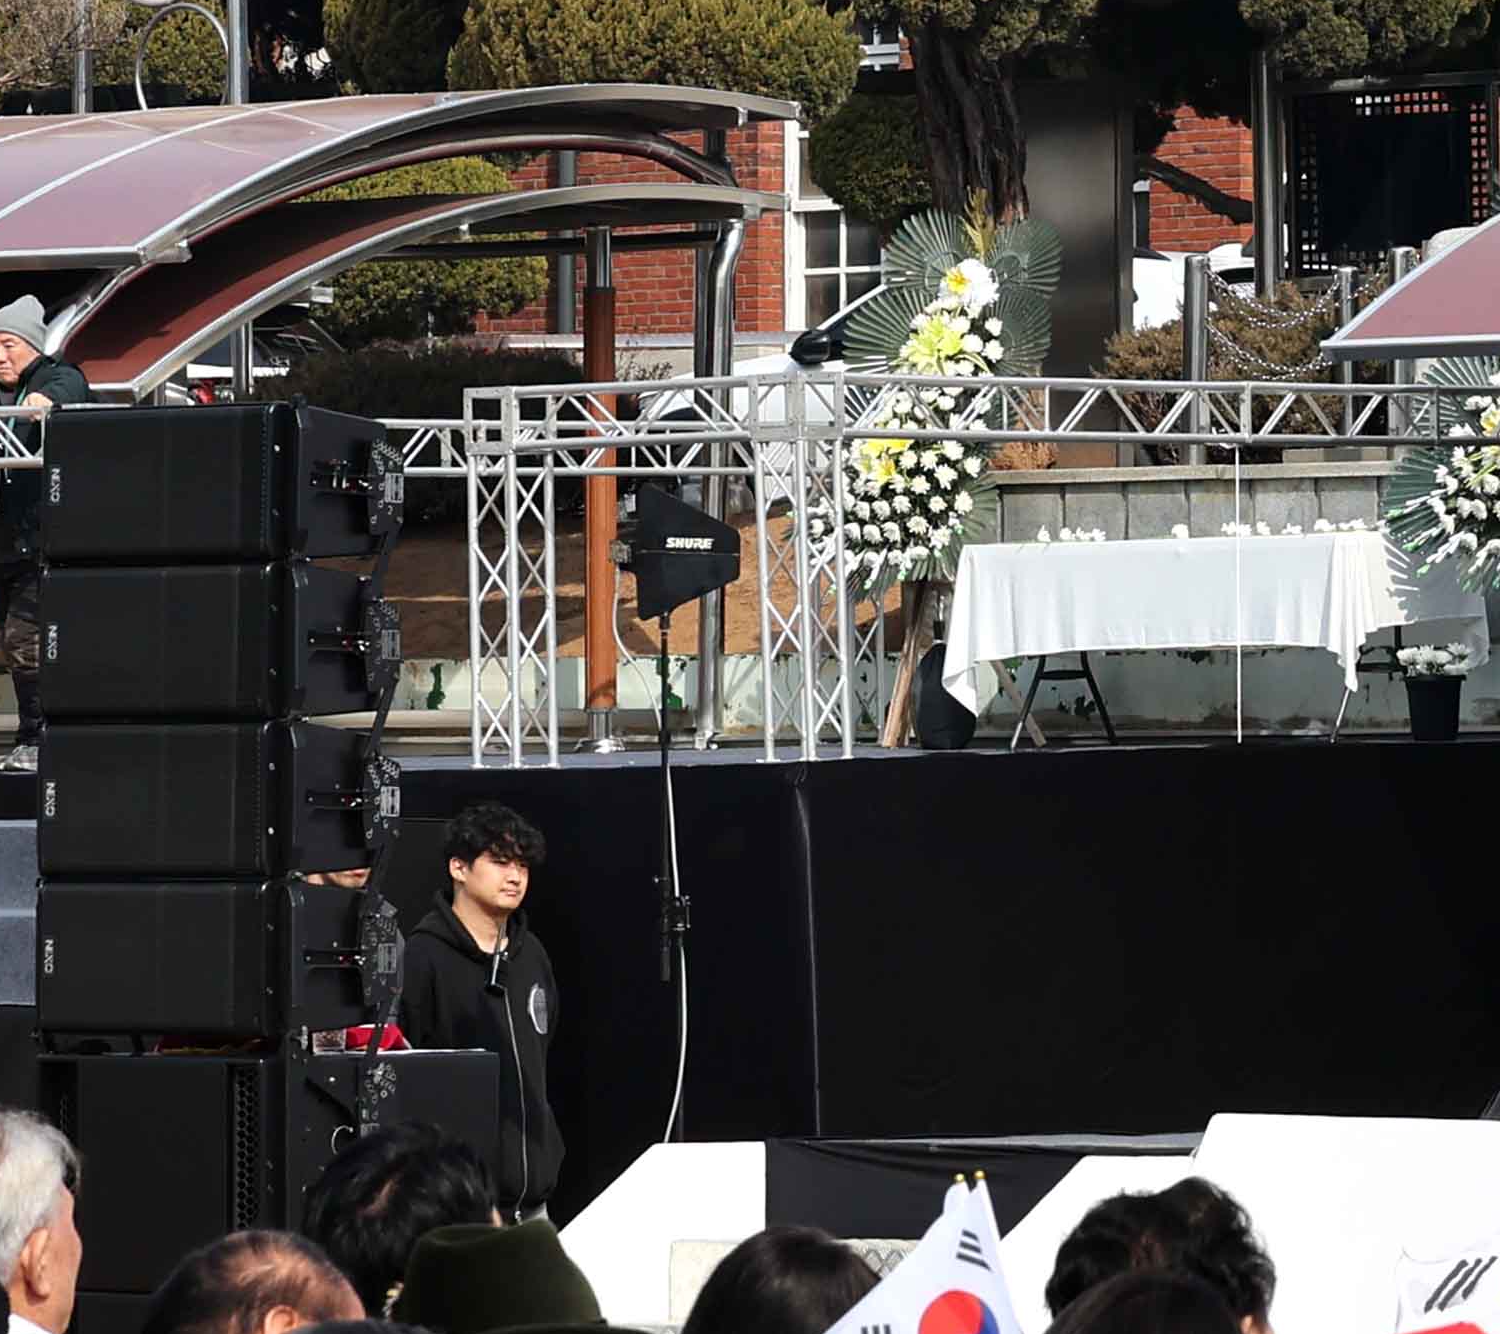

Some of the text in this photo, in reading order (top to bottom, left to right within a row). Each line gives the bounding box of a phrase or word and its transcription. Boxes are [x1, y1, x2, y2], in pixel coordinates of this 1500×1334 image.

[49, 467, 61, 503] NEXO
[665, 537, 715, 550] SHURE
[47, 624, 58, 660] NEXO
[44, 781, 56, 817] NEXO
[43, 938, 54, 974] NEXO
